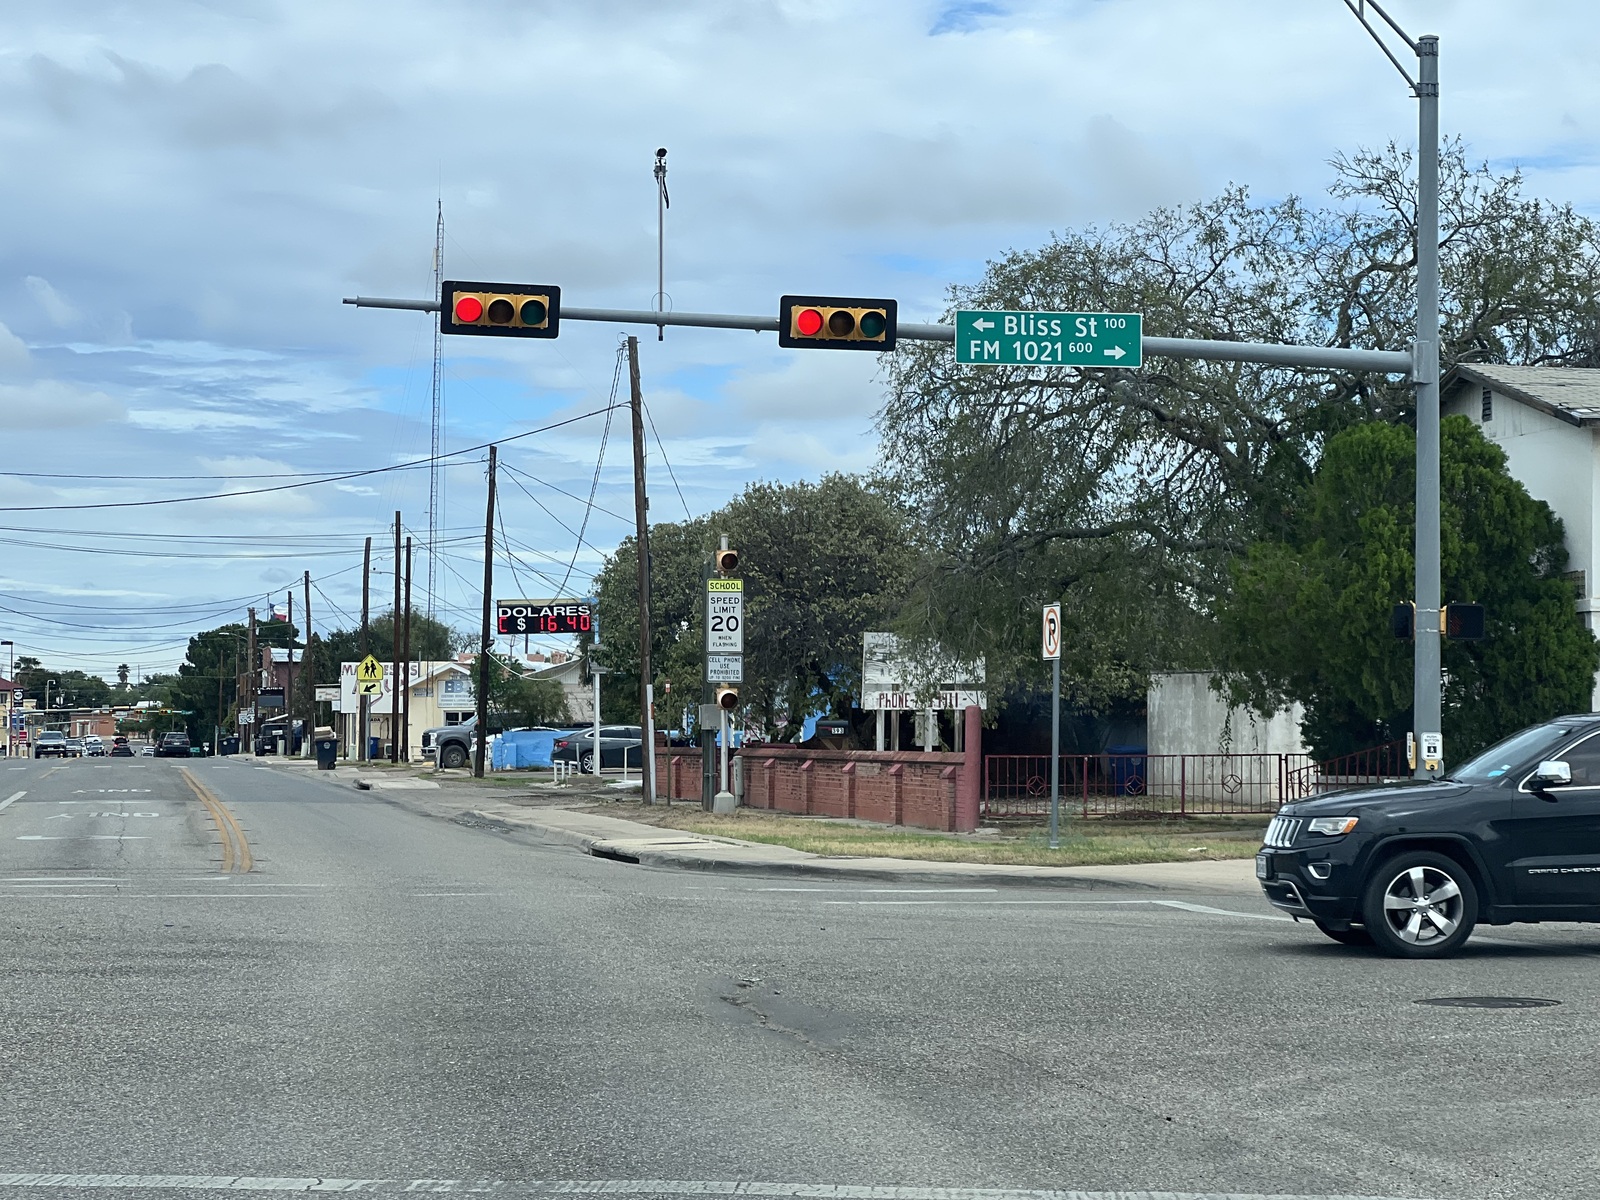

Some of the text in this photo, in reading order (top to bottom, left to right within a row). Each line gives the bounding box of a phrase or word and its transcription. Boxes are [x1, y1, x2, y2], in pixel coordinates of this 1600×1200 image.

[1004, 314, 1126, 338] Bliss St 100
[970, 340, 1093, 362] FM 1021 600
[709, 582, 741, 590] SCHOOL
[710, 597, 740, 605] SPEED
[499, 606, 591, 617] DOLARES
[540, 615, 590, 631] 16.40
[711, 615, 739, 632] 20
